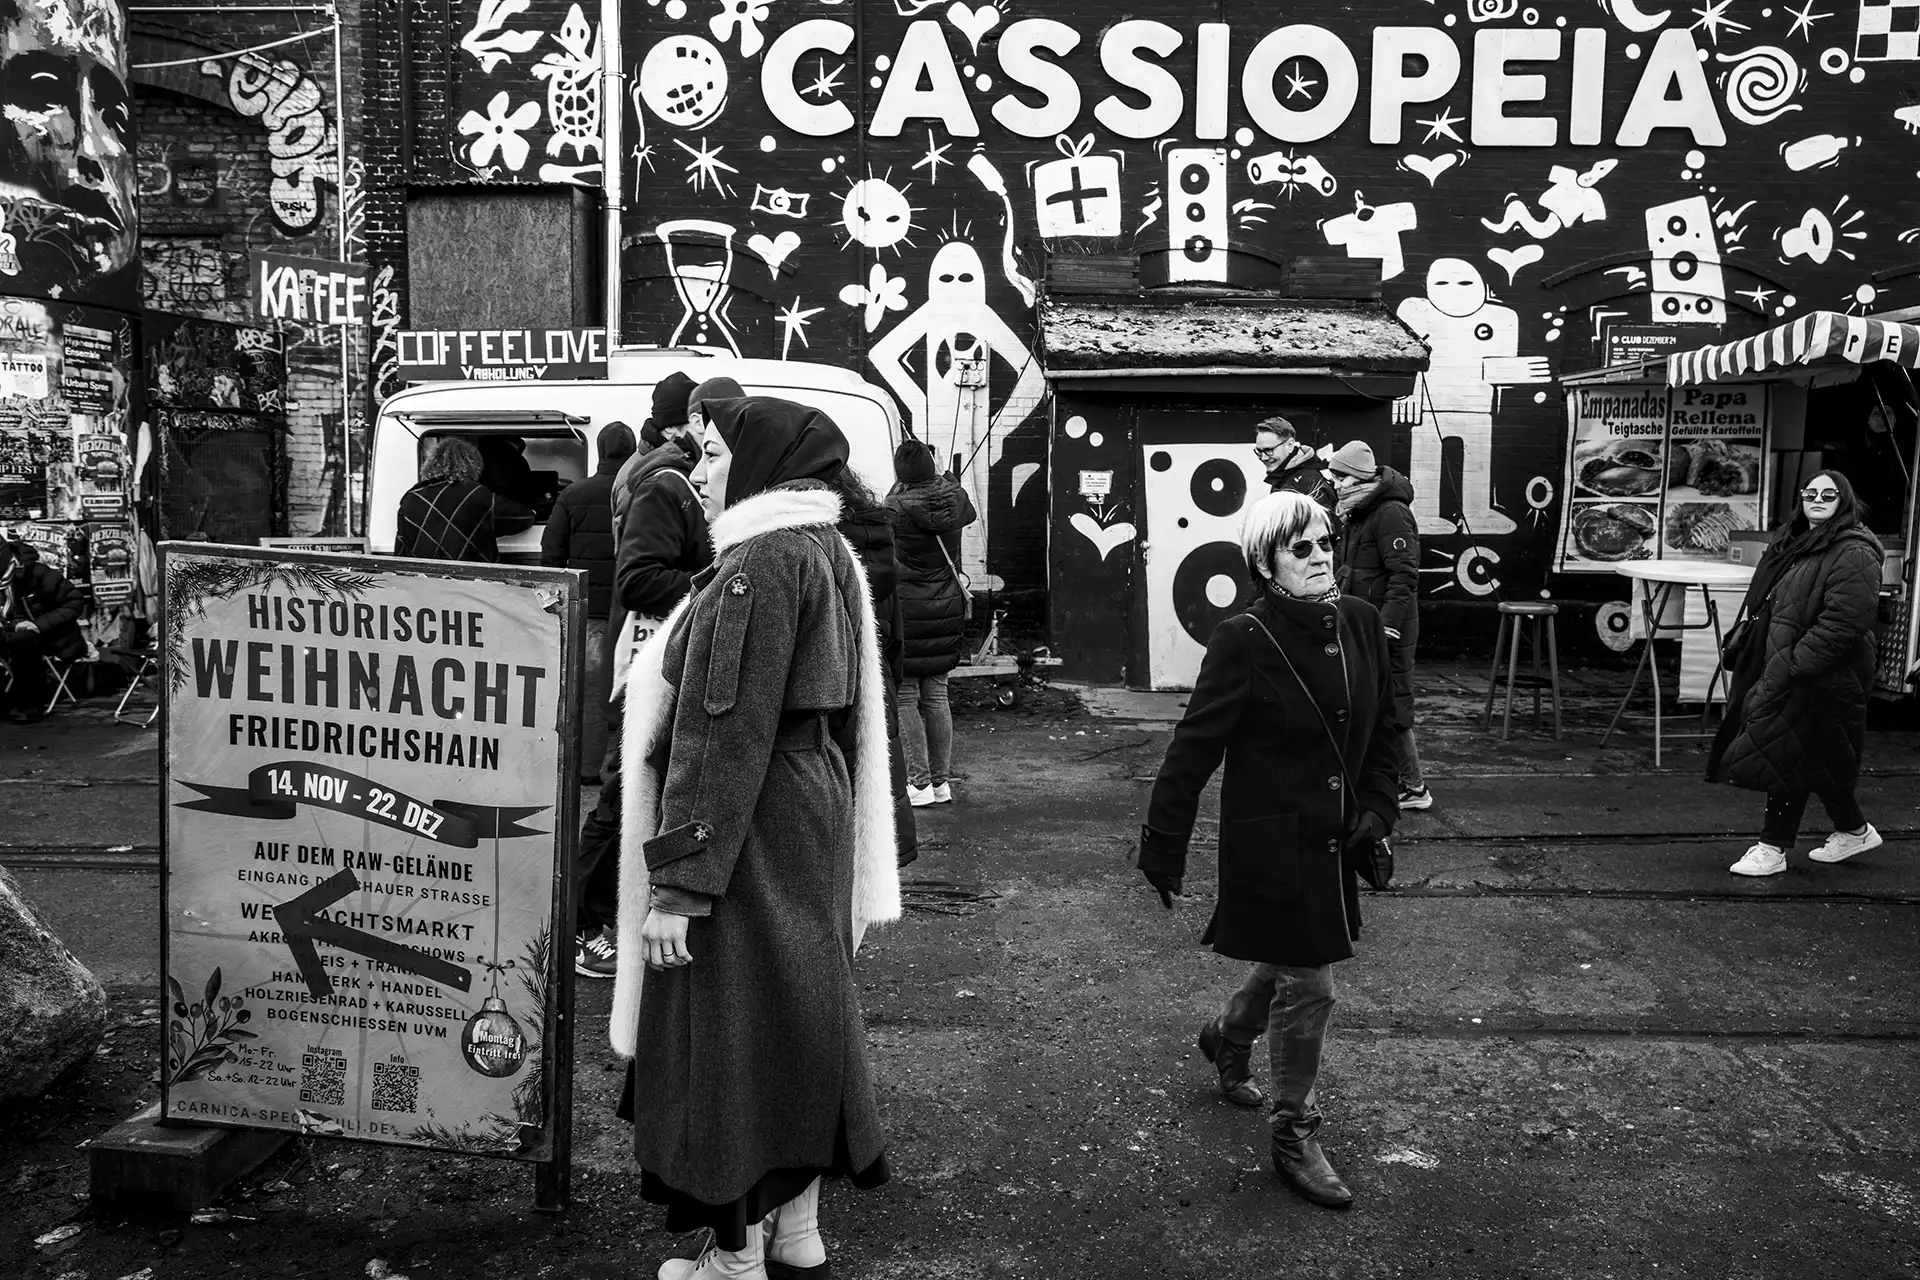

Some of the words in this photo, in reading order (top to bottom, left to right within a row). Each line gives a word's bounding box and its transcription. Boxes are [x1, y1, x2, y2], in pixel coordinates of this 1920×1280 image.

[761, 18, 1726, 147] CASSIOPEIA
[261, 260, 365, 325] KAFFEE
[1621, 335, 1642, 344] CLUB
[2, 362, 43, 372] TATTOO
[473, 367, 535, 380] ABHOLUNG
[1580, 389, 1665, 425] Empanadas
[1683, 388, 1747, 409] Papa
[1672, 410, 1756, 425] Rellena
[1608, 422, 1663, 438] Teigtasche
[1672, 426, 1709, 436] Gefüllte
[1711, 425, 1762, 435] Kartoffeln
[248, 594, 484, 648] HISTORISCHE
[192, 637, 546, 728] WEIHNACHT
[229, 713, 499, 770] FRIEDRICHSHAIN
[267, 769, 298, 797] 14.
[304, 772, 349, 804] NOV
[365, 787, 398, 822] 22.
[403, 801, 445, 840] DEZ
[254, 841, 290, 862] AUF
[297, 845, 335, 867] DEM
[343, 849, 473, 882] RAW-GELÄNDE
[238, 869, 309, 886] EINGANG
[420, 888, 491, 907] STRASSE
[241, 903, 475, 941] WEACHTSMARKT
[272, 971, 360, 989] HANERK
[381, 981, 442, 998] HANDEL
[245, 988, 368, 1009] HOLZRIESENRAD
[386, 1001, 469, 1022] KARUSSELL
[267, 1008, 407, 1033] BOGENSCHIESSEN
[414, 1023, 447, 1038] UVM
[307, 1044, 343, 1057] Instagram
[468, 1044, 501, 1057] Eintritt
[480, 1030, 514, 1047] Montag
[239, 1057, 274, 1070] 15-22
[277, 1062, 296, 1073] Uhr
[390, 1054, 405, 1064] Info
[248, 1074, 278, 1086] 12-22
[280, 1077, 297, 1088] Uhr
